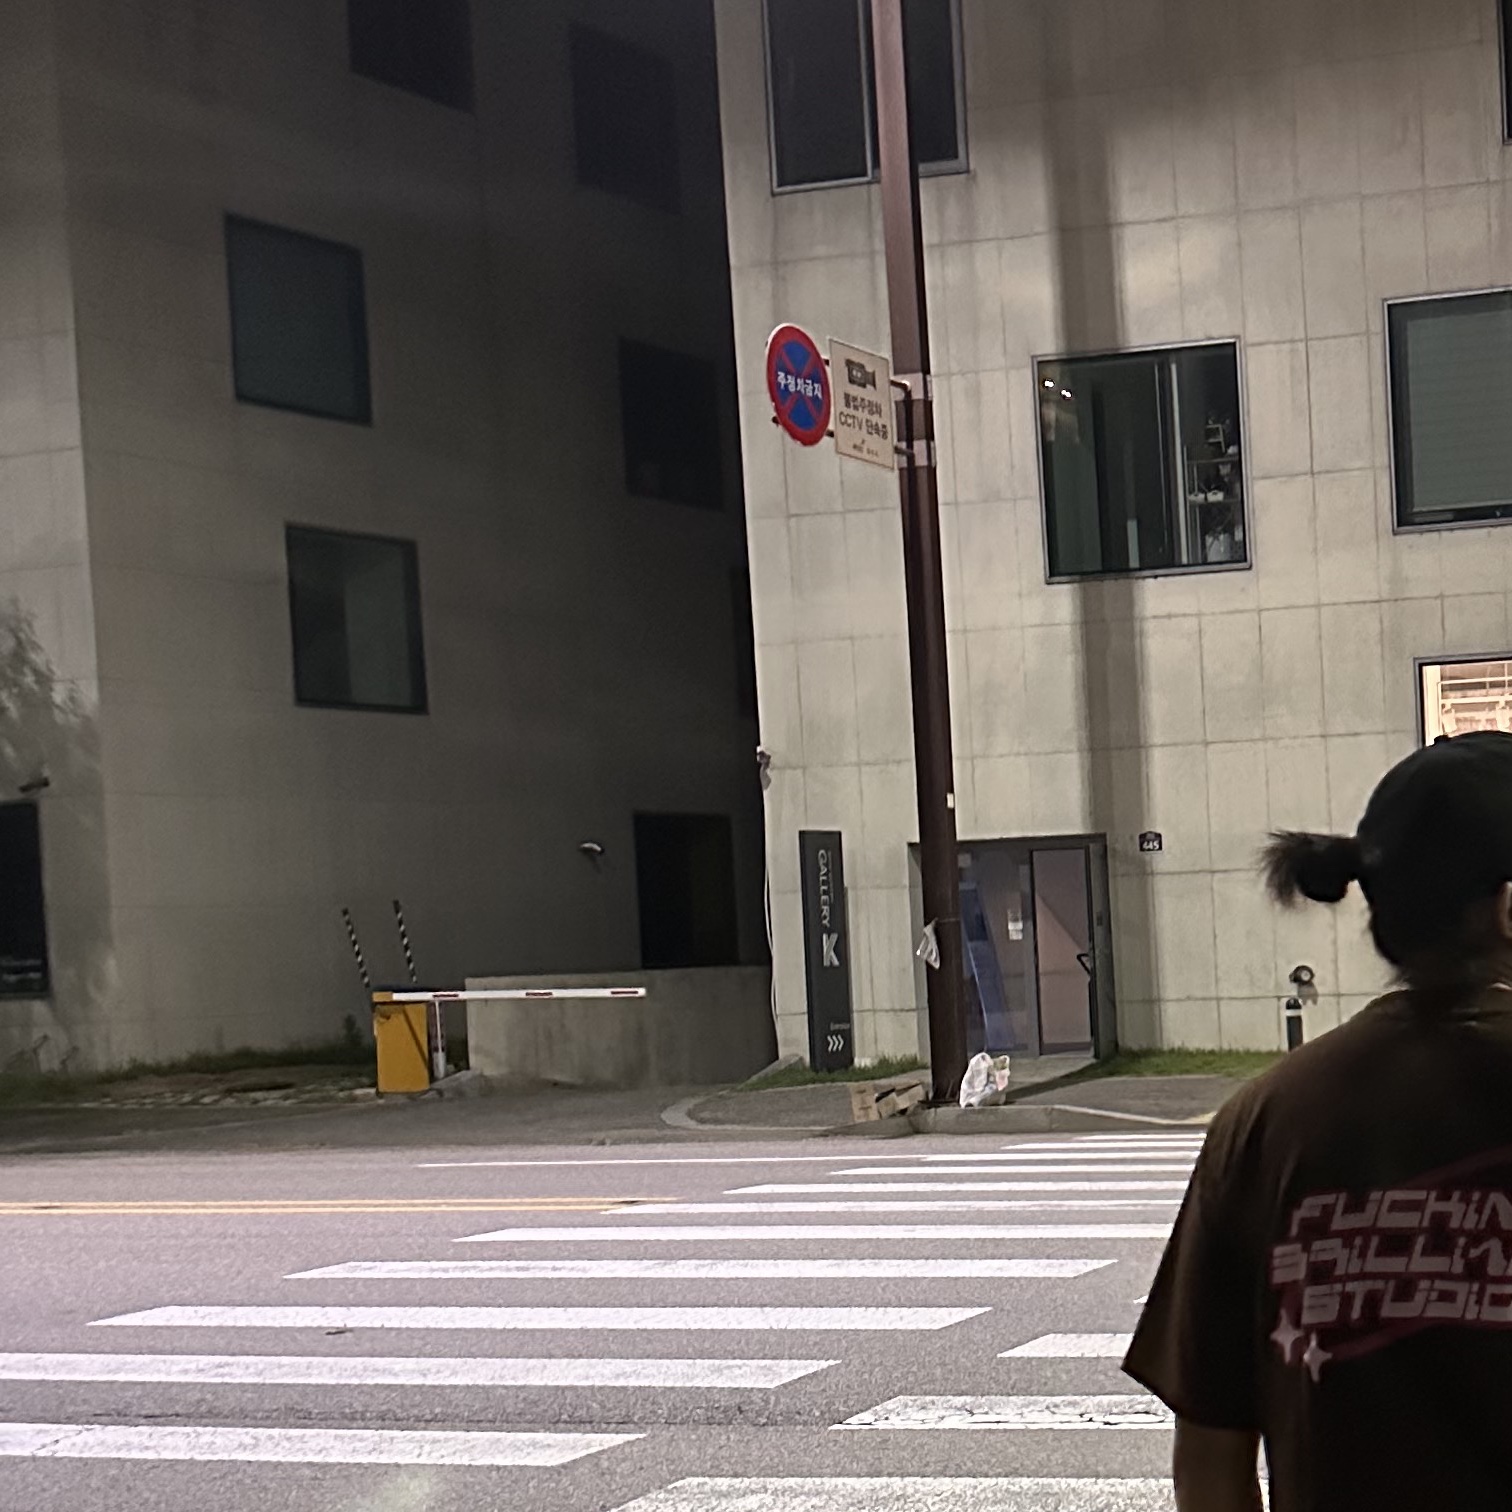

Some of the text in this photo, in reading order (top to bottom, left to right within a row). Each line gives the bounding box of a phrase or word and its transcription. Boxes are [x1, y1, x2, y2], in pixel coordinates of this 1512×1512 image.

[777, 371, 823, 400] 주정차금지
[838, 411, 889, 440] CCTV 단속중
[817, 849, 831, 929] GALLERY
[822, 932, 840, 968] K
